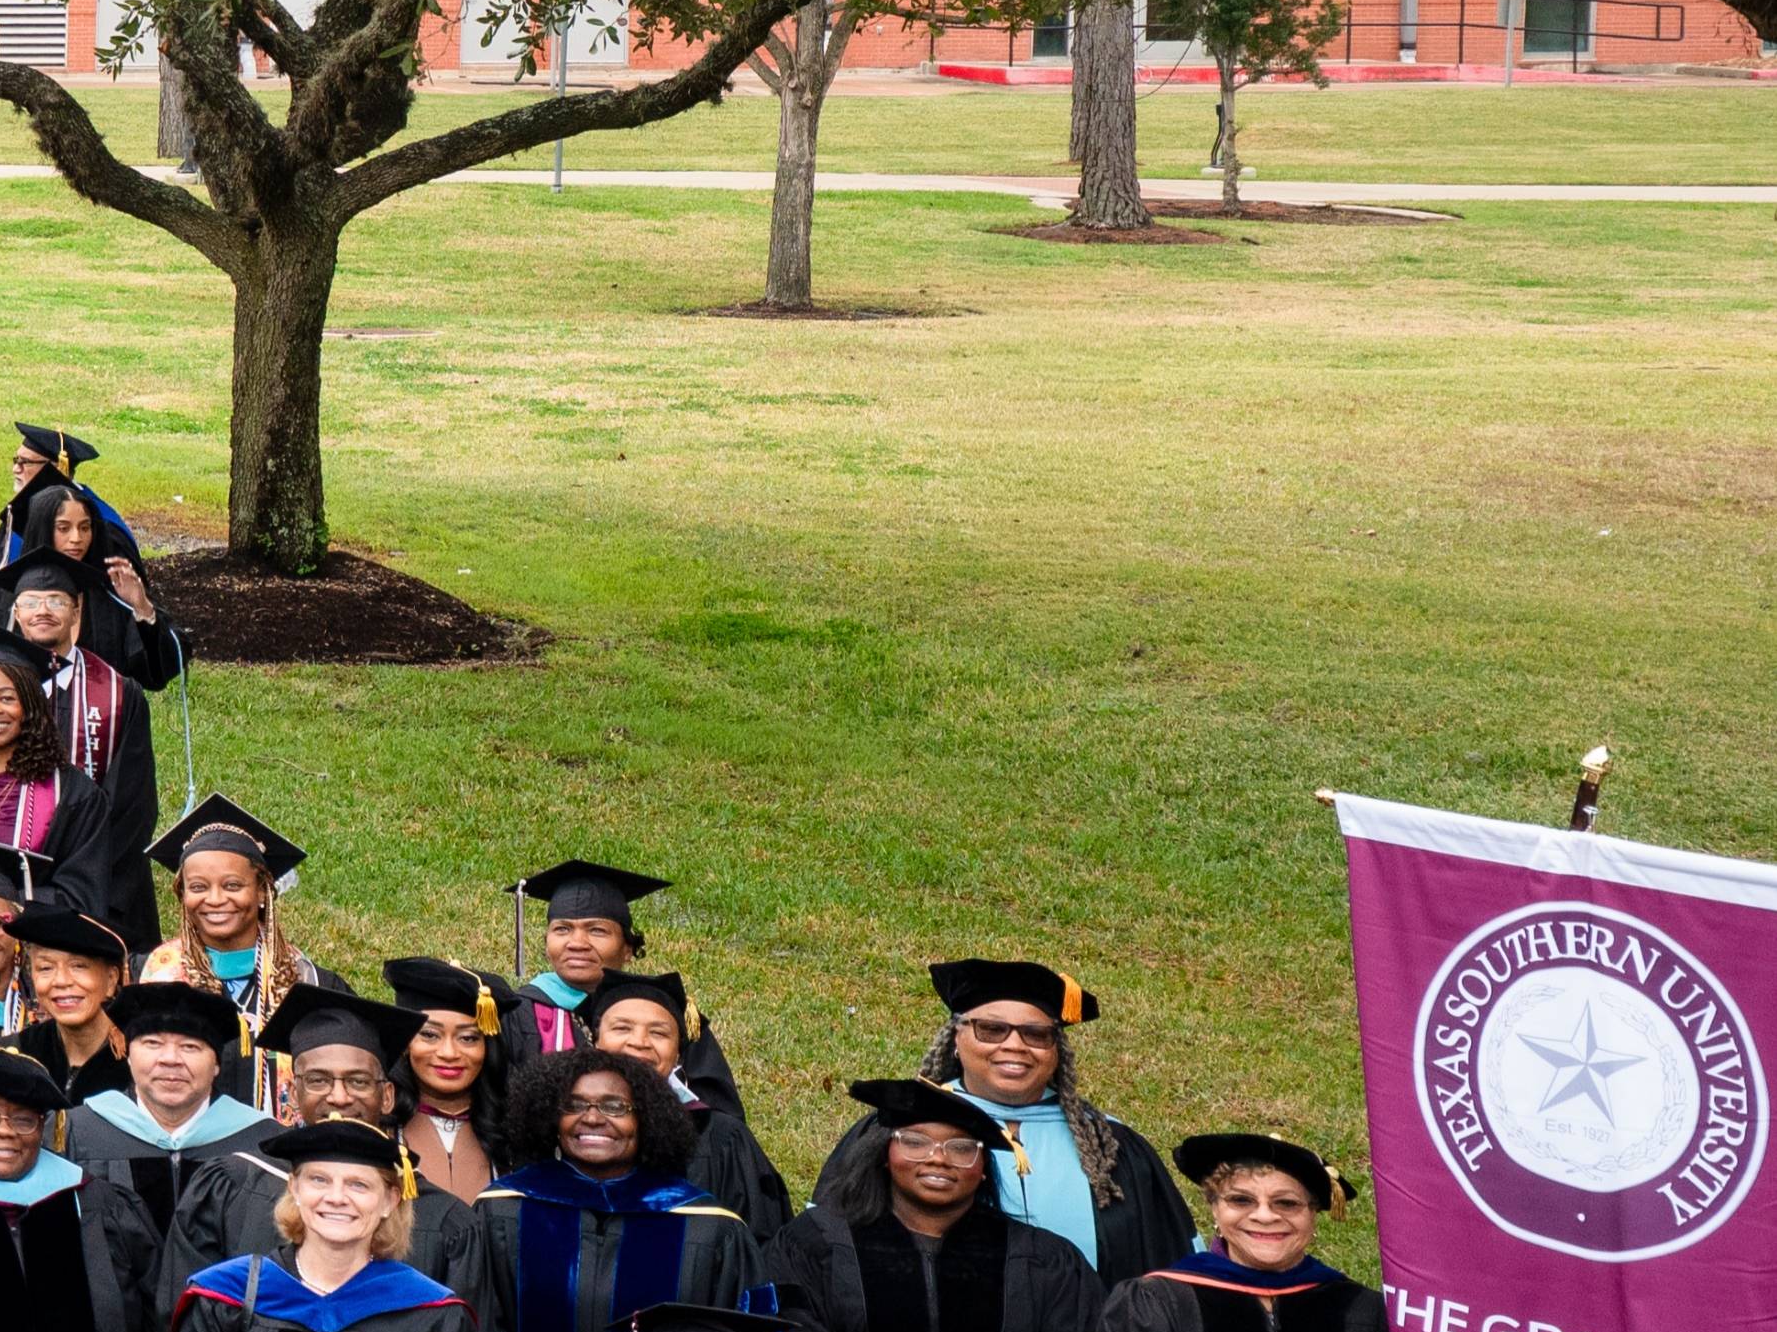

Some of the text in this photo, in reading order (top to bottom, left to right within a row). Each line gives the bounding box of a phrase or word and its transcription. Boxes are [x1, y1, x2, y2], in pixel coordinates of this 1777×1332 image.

[1436, 921, 1748, 1226] TEXAS SOUTHERN UNIVERSITY
[1544, 1117, 1613, 1143] Est. 1927
